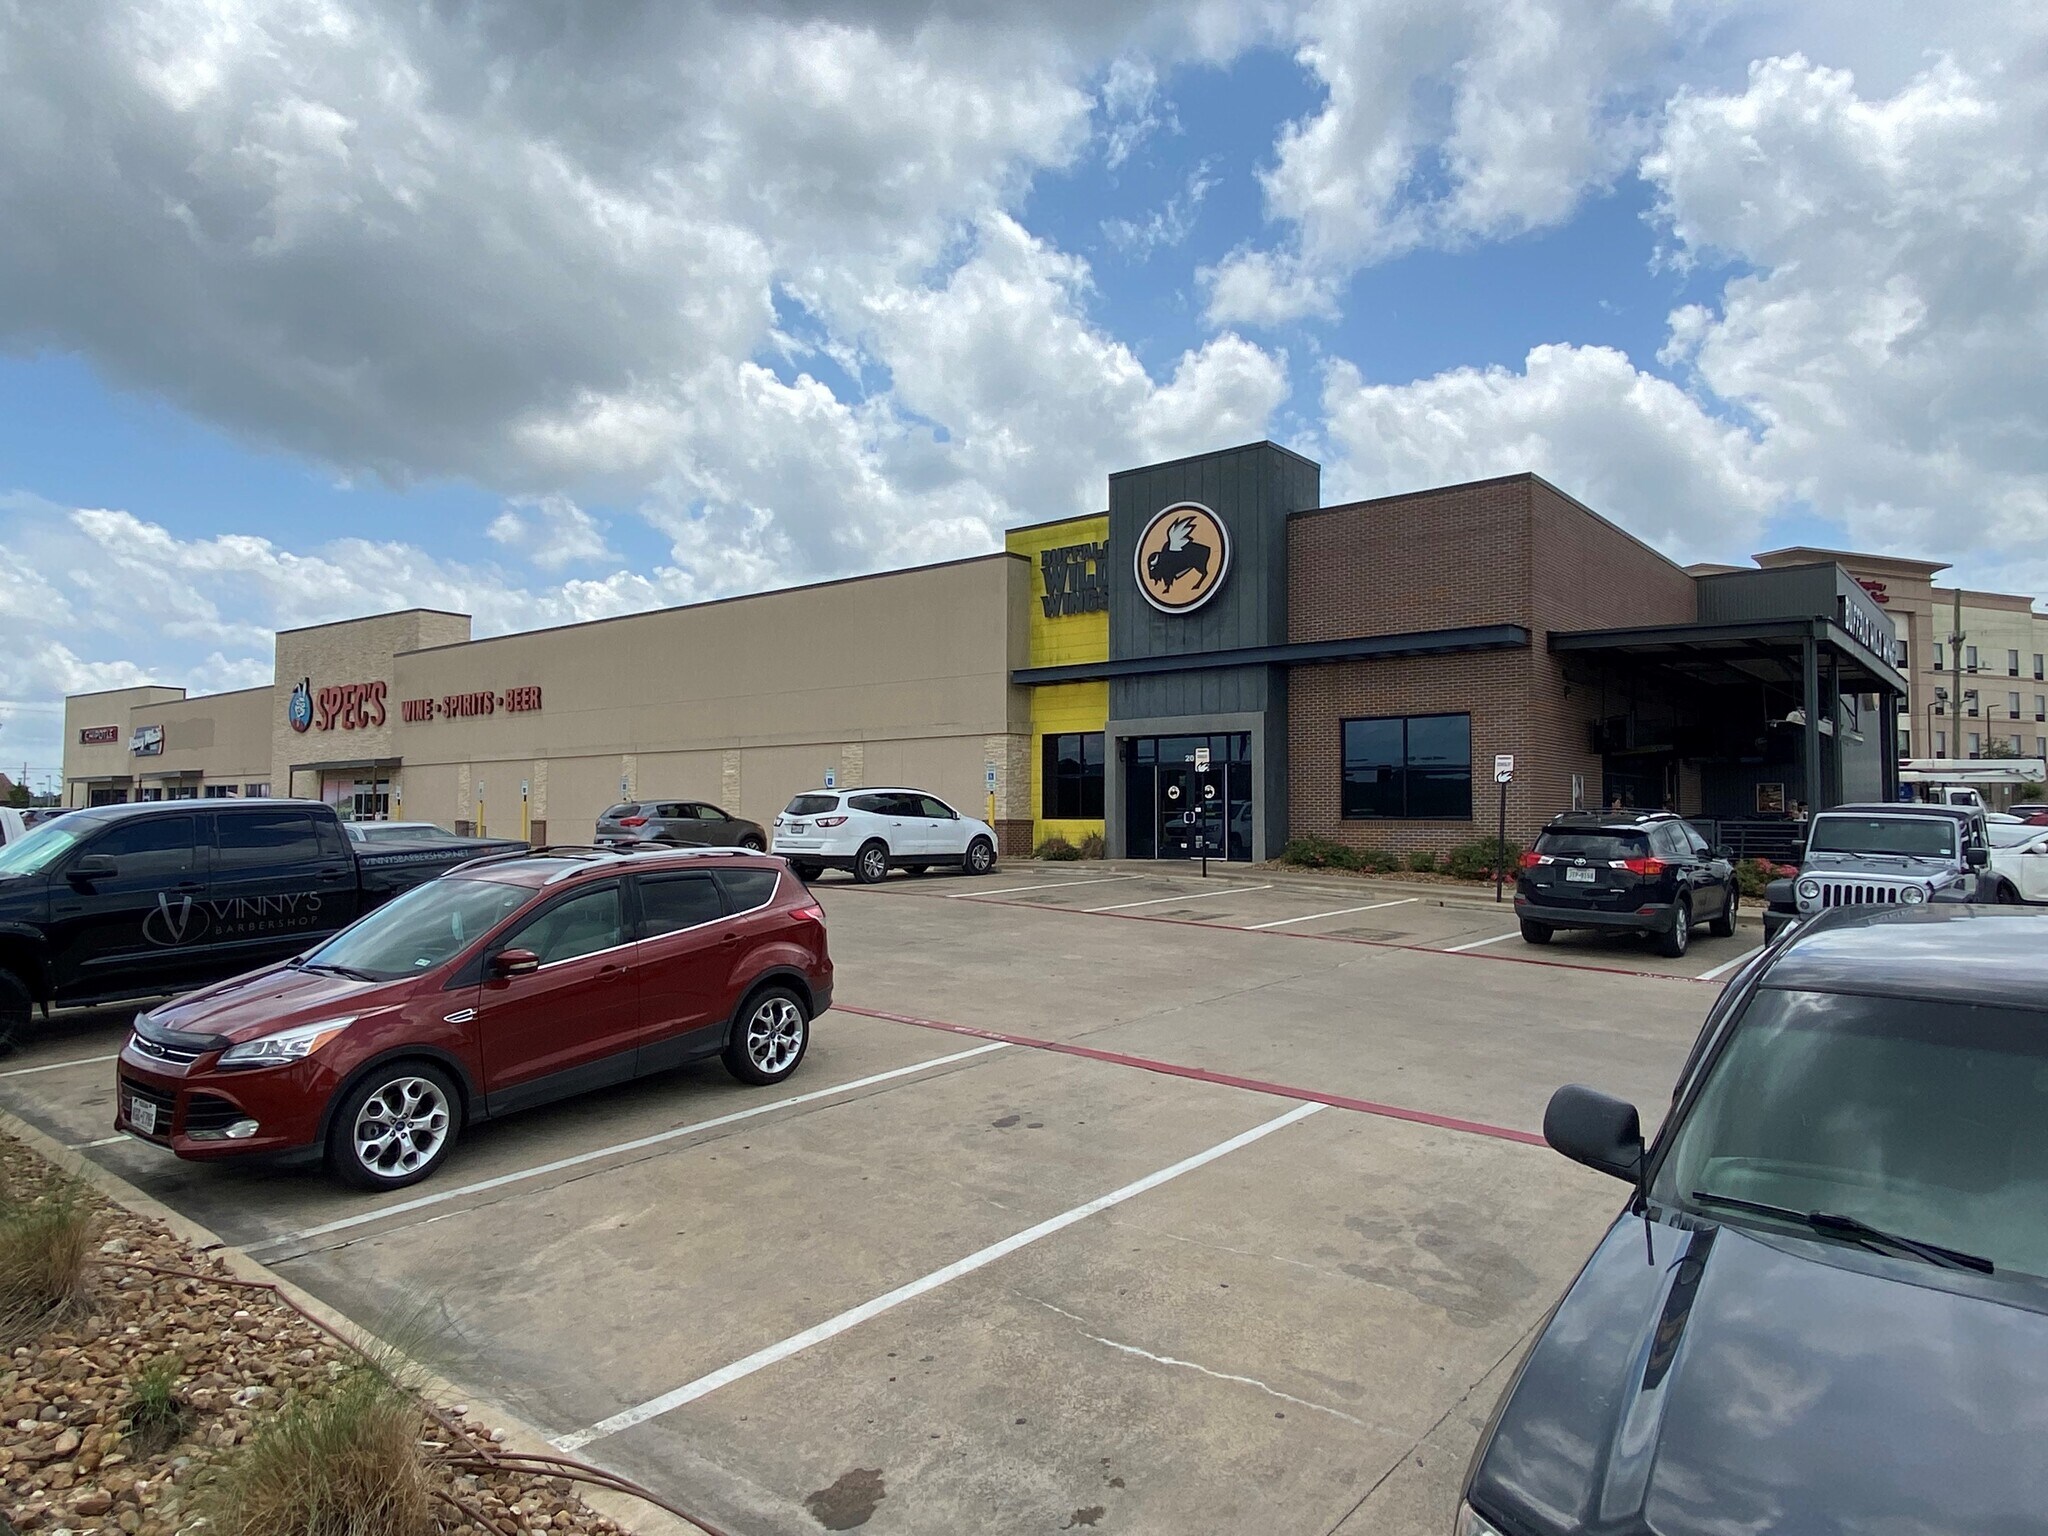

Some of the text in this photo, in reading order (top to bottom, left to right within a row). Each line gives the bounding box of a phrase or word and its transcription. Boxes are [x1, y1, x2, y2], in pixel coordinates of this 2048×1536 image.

[1040, 558, 1109, 594] WILD
[1040, 587, 1109, 618] WINGS
[316, 681, 387, 731] SPEC'S
[402, 686, 542, 722] WINE SPIRITS BEER
[85, 729, 114, 741] CHIPOTLE
[210, 891, 322, 920] VINNY'S
[215, 915, 318, 935] BARBERSHOP
